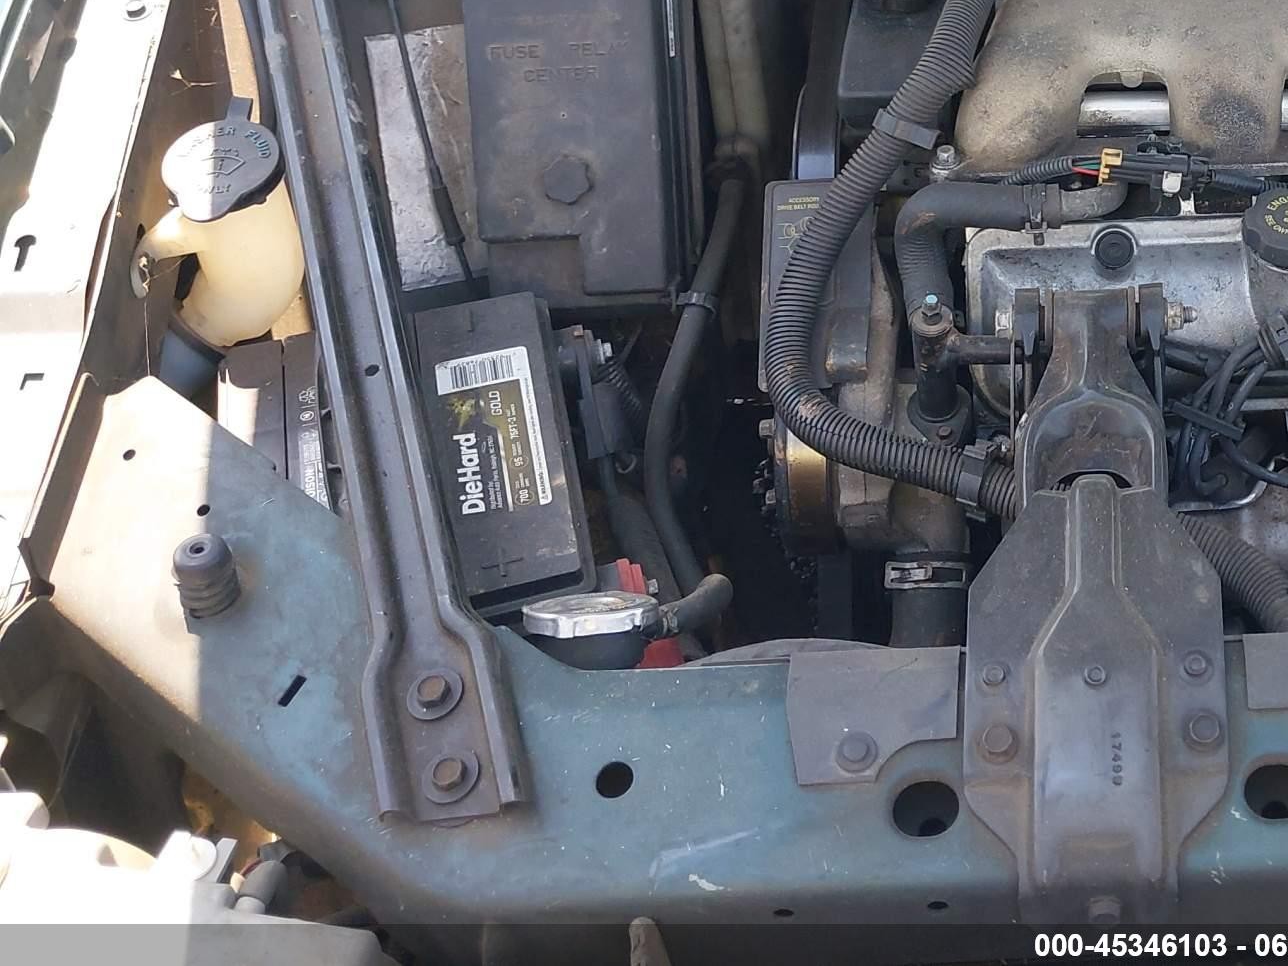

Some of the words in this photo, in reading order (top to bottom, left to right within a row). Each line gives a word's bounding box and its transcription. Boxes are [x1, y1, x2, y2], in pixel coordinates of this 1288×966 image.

[487, 44, 540, 60] FUSE
[567, 41, 629, 57] RELAY
[524, 65, 601, 83] CENTER
[245, 129, 272, 159] FLUID
[1264, 214, 1277, 227] SEE
[488, 390, 503, 416] GOLD
[514, 456, 524, 467] 95
[453, 431, 487, 515] DieHard
[519, 489, 530, 503] 700
